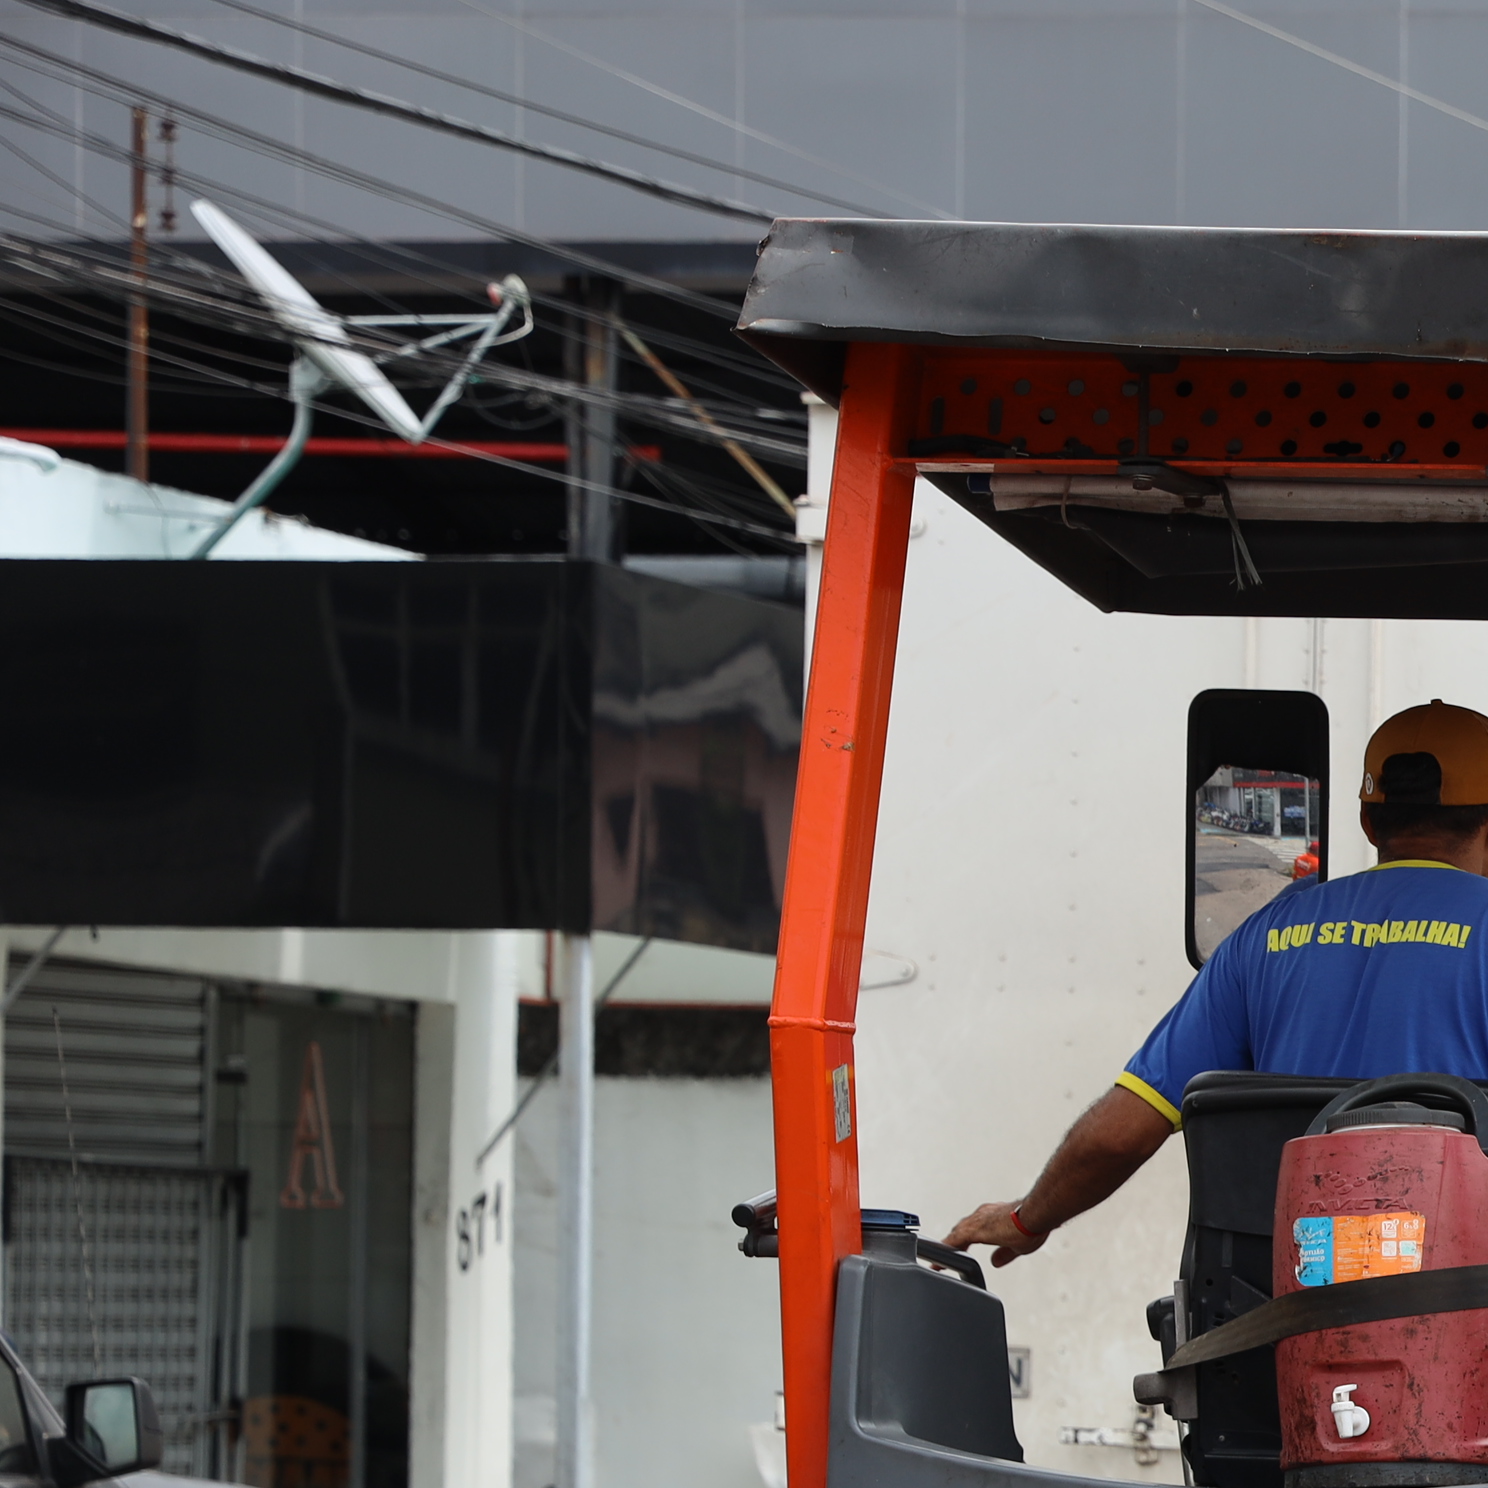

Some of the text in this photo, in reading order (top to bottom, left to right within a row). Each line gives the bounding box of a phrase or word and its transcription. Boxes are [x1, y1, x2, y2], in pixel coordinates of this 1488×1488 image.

[1267, 919, 1472, 952] AQUI SE TRABALHA!
[456, 1181, 505, 1273] 871
